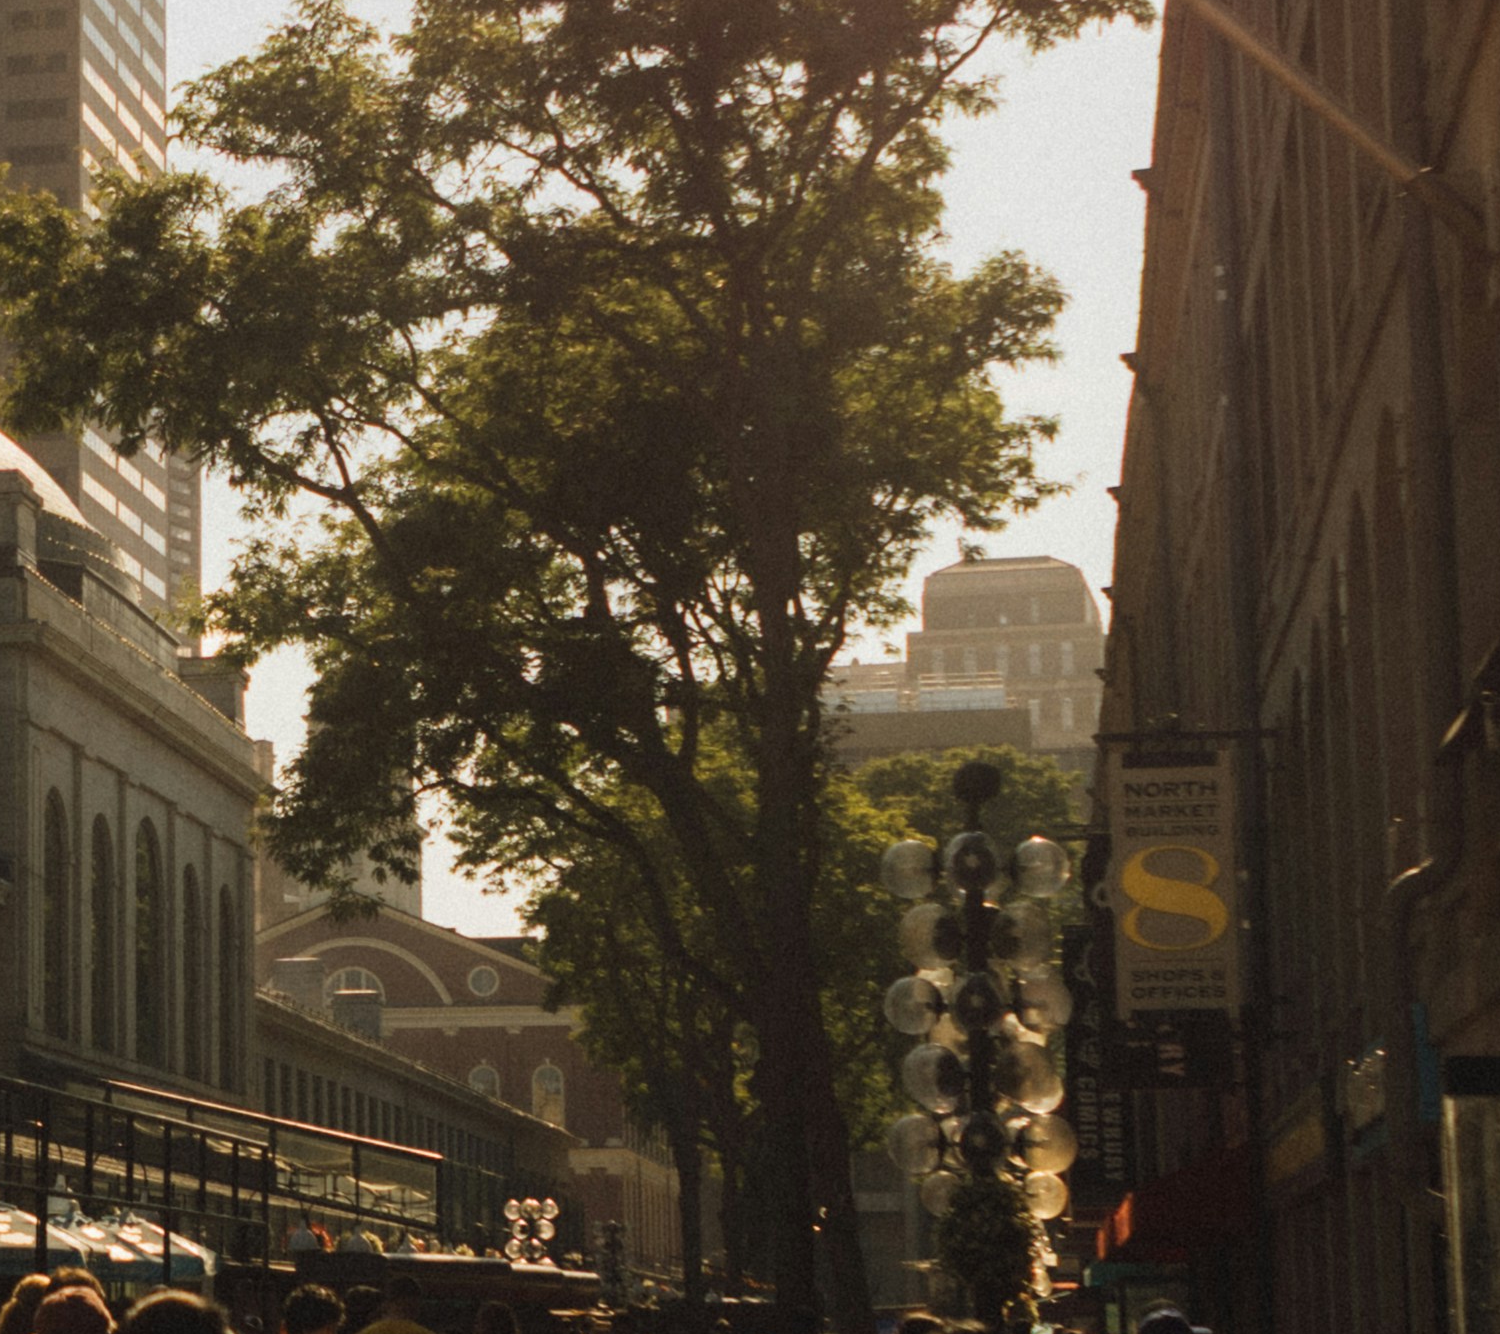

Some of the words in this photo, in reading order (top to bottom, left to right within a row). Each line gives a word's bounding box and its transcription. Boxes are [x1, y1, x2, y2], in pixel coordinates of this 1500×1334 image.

[1123, 780, 1219, 798] NORTH
[1124, 803, 1220, 818] MARKET
[1125, 823, 1221, 838] BUILDING
[1121, 845, 1229, 951] 8
[1131, 968, 1206, 983] SHOPS
[1130, 985, 1228, 1000] OFFICES
[1076, 1076, 1100, 1161] COMICS
[1101, 1091, 1126, 1182] EWBURY
